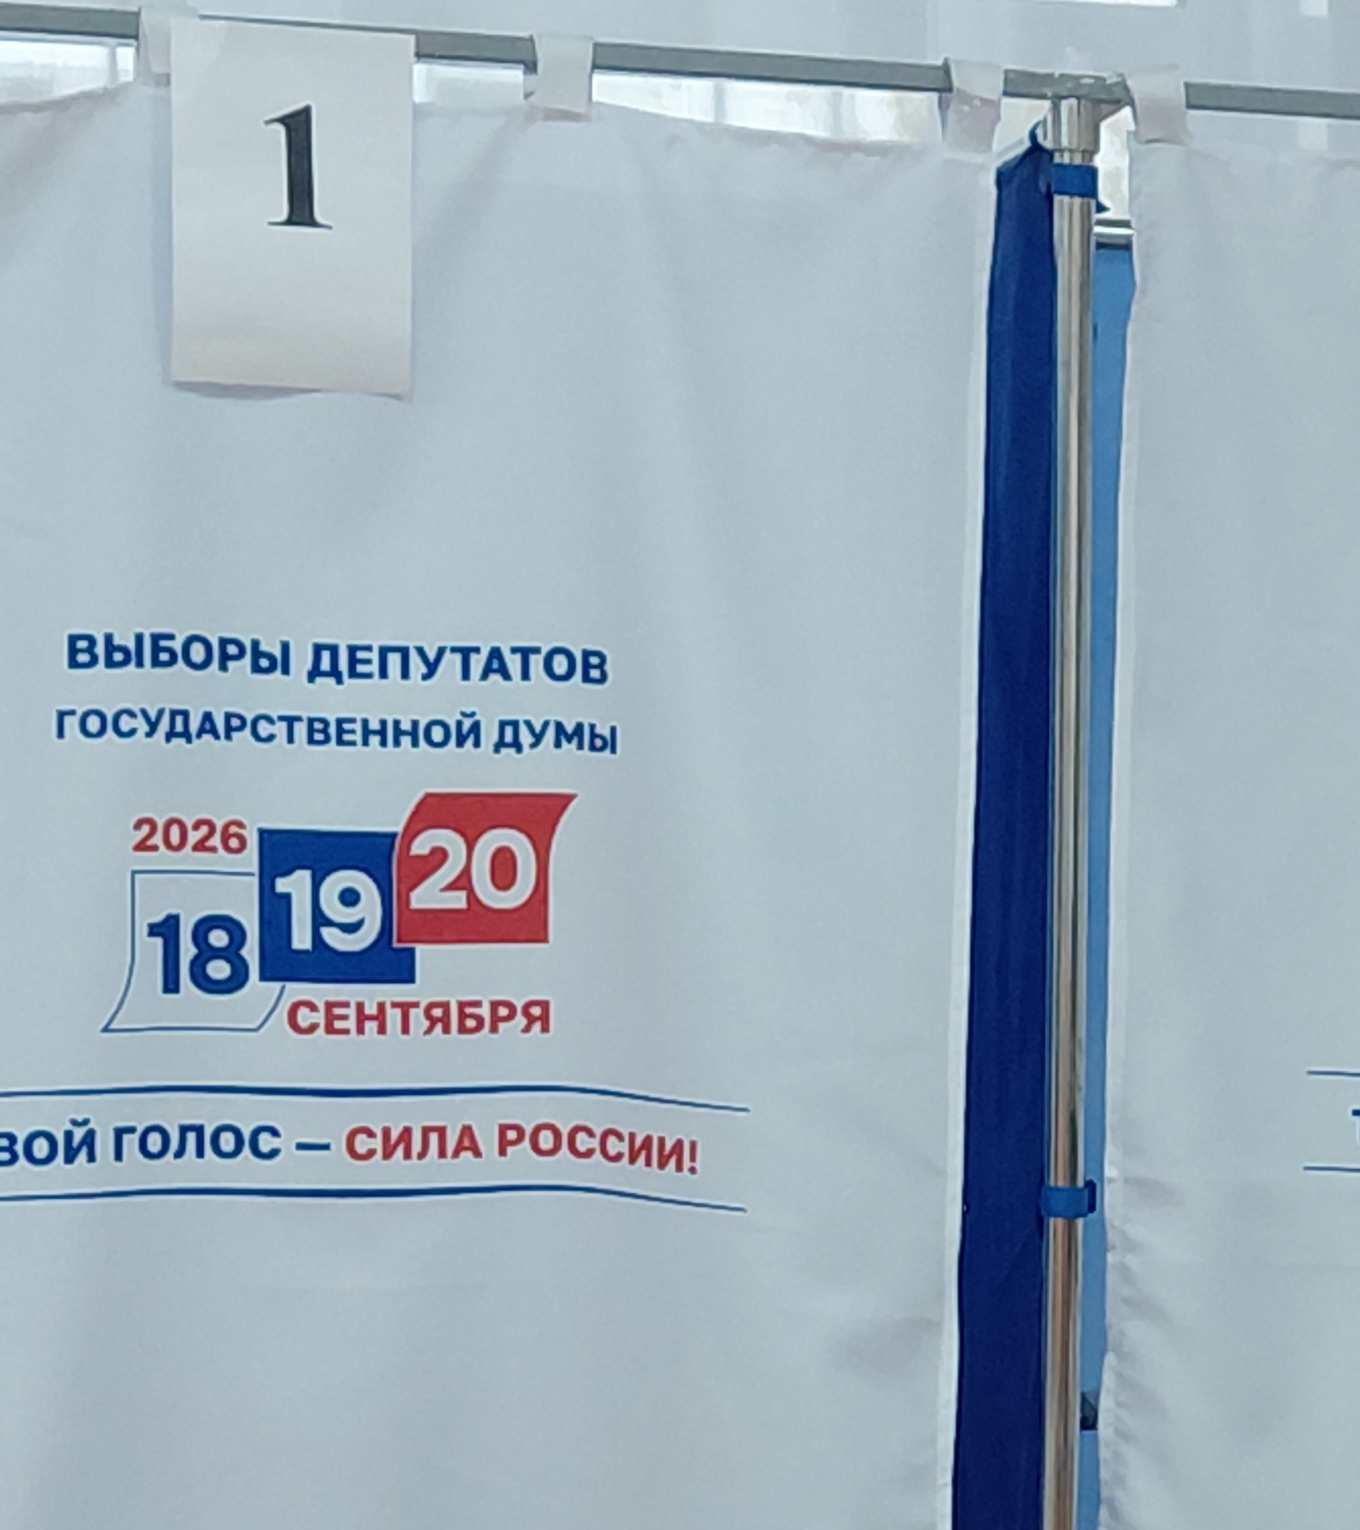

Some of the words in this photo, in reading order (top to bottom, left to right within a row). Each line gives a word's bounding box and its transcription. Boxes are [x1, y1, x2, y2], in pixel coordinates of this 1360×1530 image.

[263, 103, 333, 231] 1
[66, 631, 291, 677] ВЫБОРЫ
[306, 641, 609, 686] ДЕПУТАТОВ
[55, 706, 482, 750] ГОСУДАРСТВЕННОЙ
[492, 718, 618, 756] ДУМЫ
[132, 817, 248, 855] 2026
[146, 913, 251, 995] 18
[275, 869, 383, 952] 19
[408, 827, 538, 910] 20
[287, 1000, 551, 1037] СЕНТЯБРЯ
[0, 1117, 98, 1168] ВОЙ
[112, 1123, 283, 1163] ГОЛОС
[345, 1124, 482, 1162] СИЛА
[497, 1122, 698, 1175] РОССИИ!
